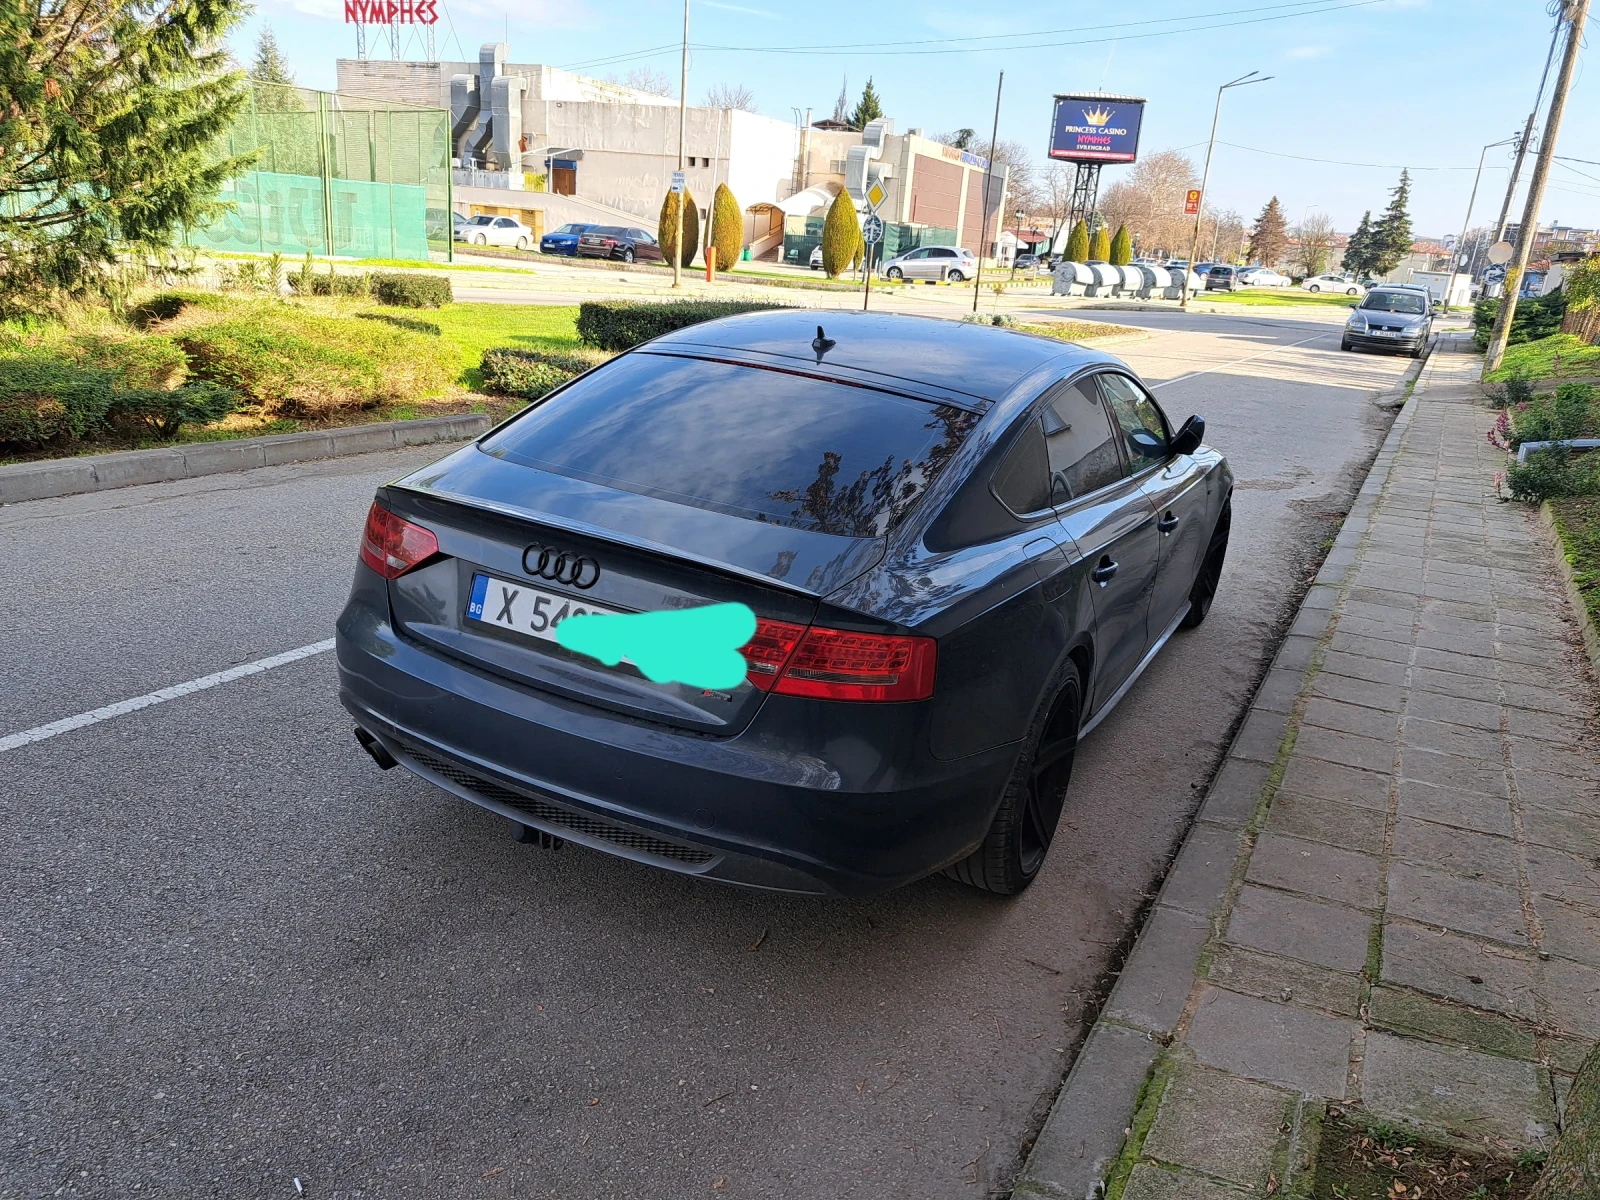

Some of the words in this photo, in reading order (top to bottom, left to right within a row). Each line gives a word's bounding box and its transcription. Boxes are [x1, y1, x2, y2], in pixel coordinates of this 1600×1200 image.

[345, 0, 439, 25] NYMPHES
[1065, 125, 1097, 134] PRINCESS
[1098, 127, 1127, 136] CASINO
[1077, 134, 1112, 145] NYMPHES
[470, 602, 483, 614] BG
[496, 586, 519, 625] X
